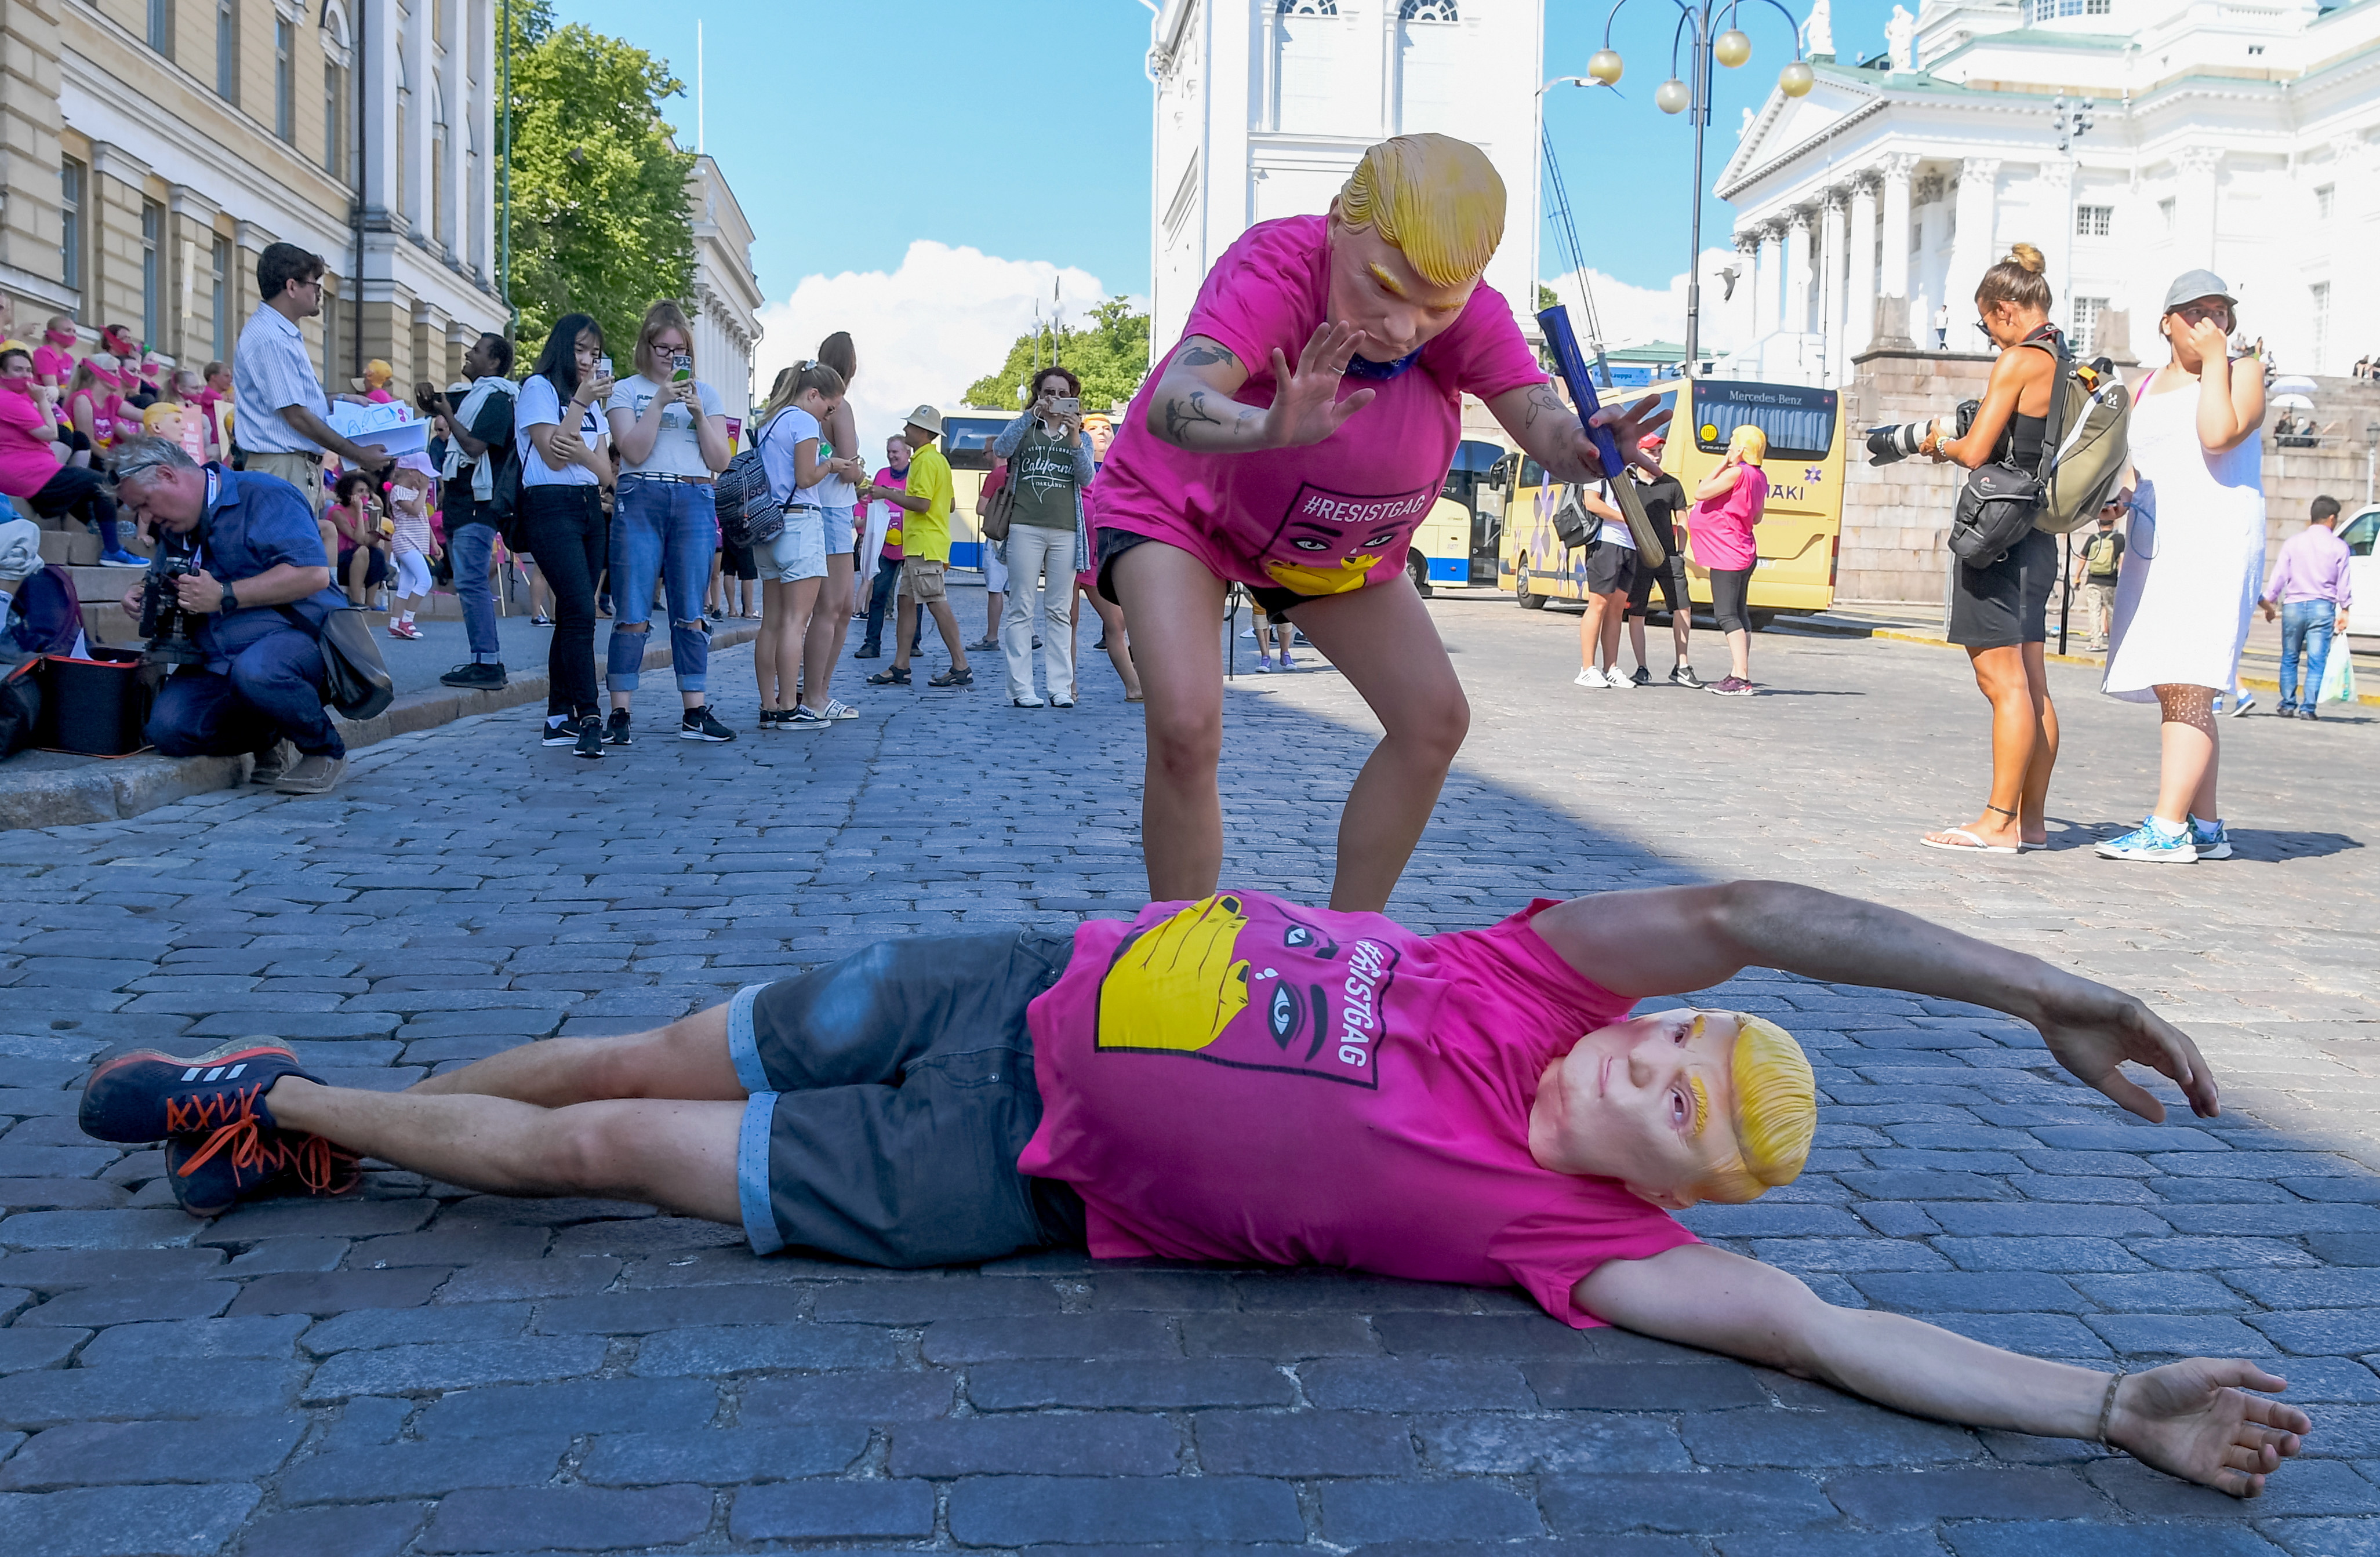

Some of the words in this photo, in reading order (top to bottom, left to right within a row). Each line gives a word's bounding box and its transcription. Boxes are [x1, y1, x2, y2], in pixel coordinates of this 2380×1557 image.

[1729, 390, 1803, 406] Mercedes-Benz
[1703, 428, 1716, 438] 100
[1302, 494, 1426, 522] #RESISTGAG
